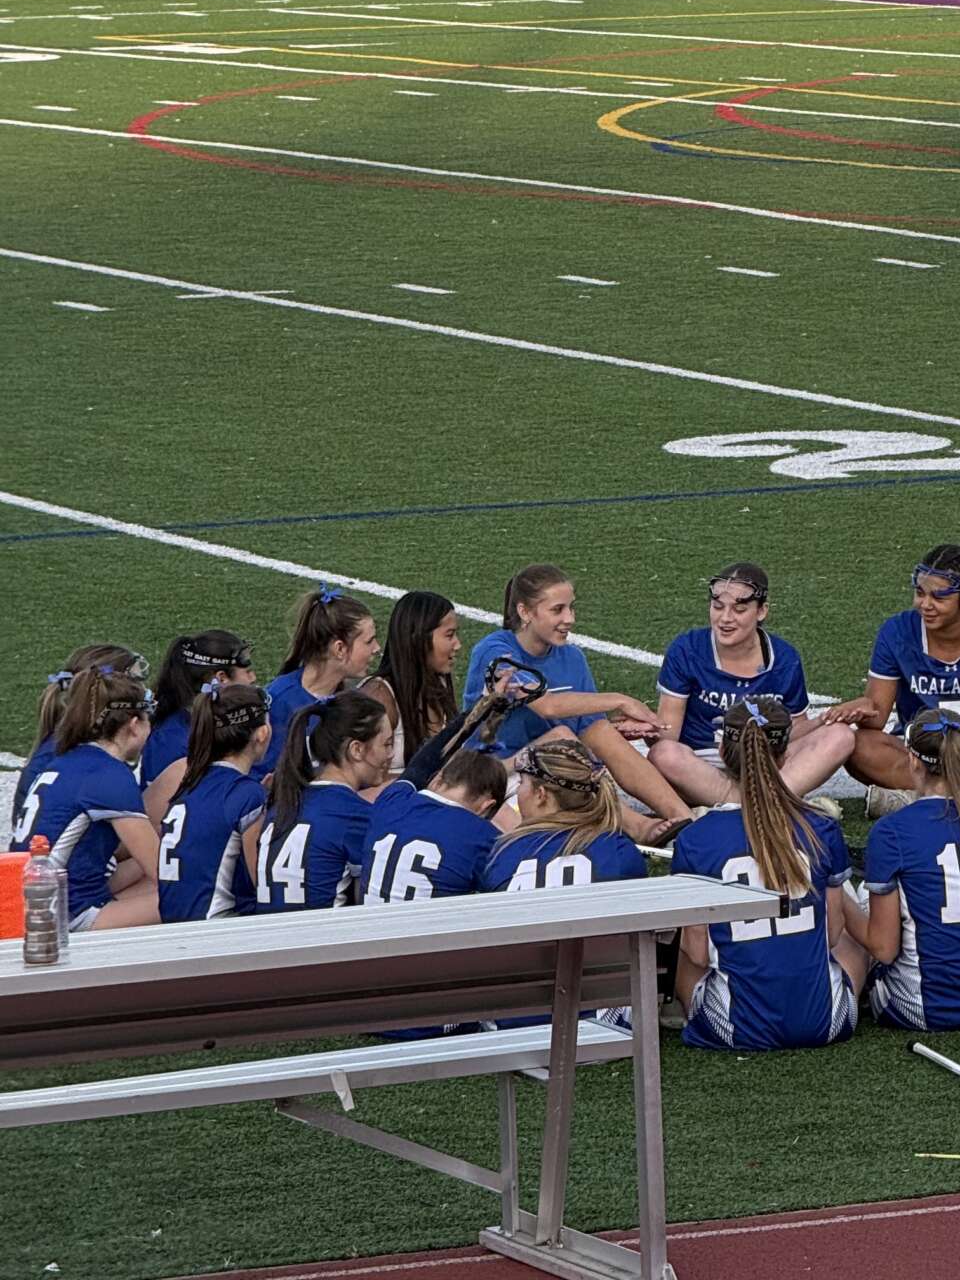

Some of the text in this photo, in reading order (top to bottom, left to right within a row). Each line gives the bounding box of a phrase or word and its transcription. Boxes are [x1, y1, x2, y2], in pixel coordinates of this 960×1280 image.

[14, 772, 59, 843] 5
[159, 803, 187, 881] 2
[257, 822, 311, 904] 14
[363, 833, 442, 906] 16
